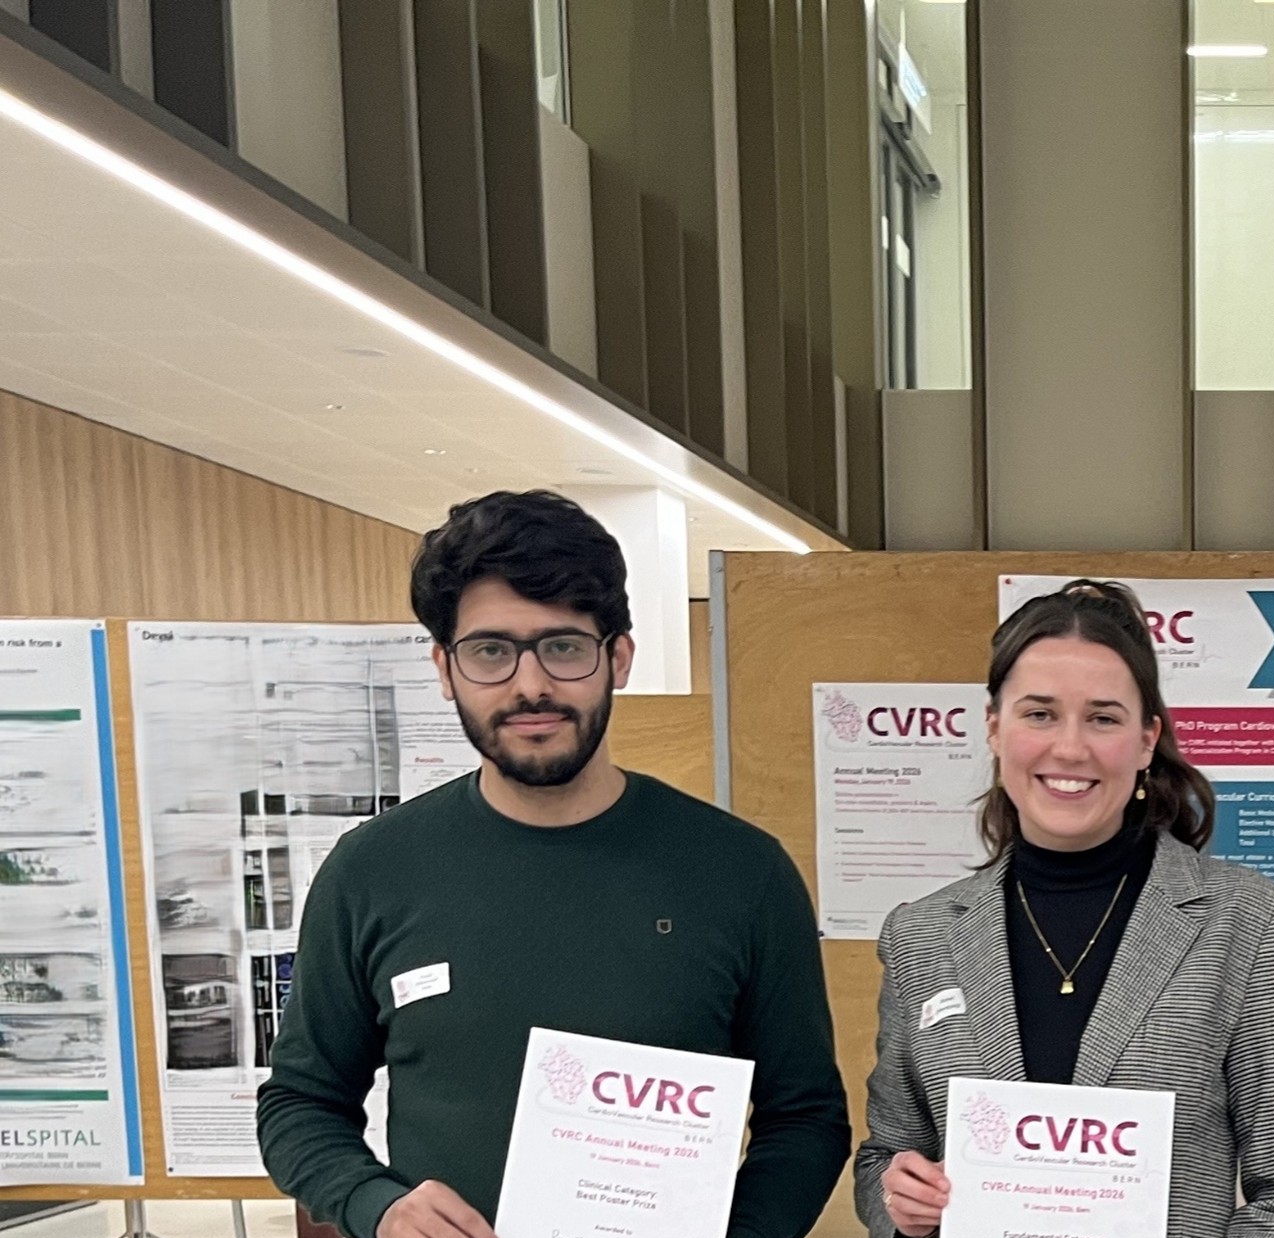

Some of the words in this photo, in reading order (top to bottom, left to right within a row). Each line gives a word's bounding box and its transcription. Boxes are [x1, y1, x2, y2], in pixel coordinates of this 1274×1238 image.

[866, 706, 967, 738] CVRC
[1175, 722, 1195, 730] PhD
[1197, 722, 1238, 732] Program
[834, 767, 862, 775] Annual
[866, 768, 899, 777] Meeting
[902, 768, 921, 776] 2026
[592, 1071, 716, 1118] CVRC
[552, 1128, 583, 1141] CVRC
[585, 1134, 625, 1148] Annual
[628, 1140, 670, 1156] Meeting
[674, 1147, 699, 1158] 2026
[1015, 1114, 1138, 1156] CVRC
[578, 1179, 612, 1192] Clinical
[981, 1182, 1012, 1191] CVRC
[1014, 1184, 1052, 1195] Annual
[1054, 1186, 1098, 1199] Meeting
[1099, 1189, 1125, 1199] 2026
[576, 1190, 598, 1200] Best
[600, 1194, 630, 1205] Poster
[632, 1199, 656, 1210] Prize
